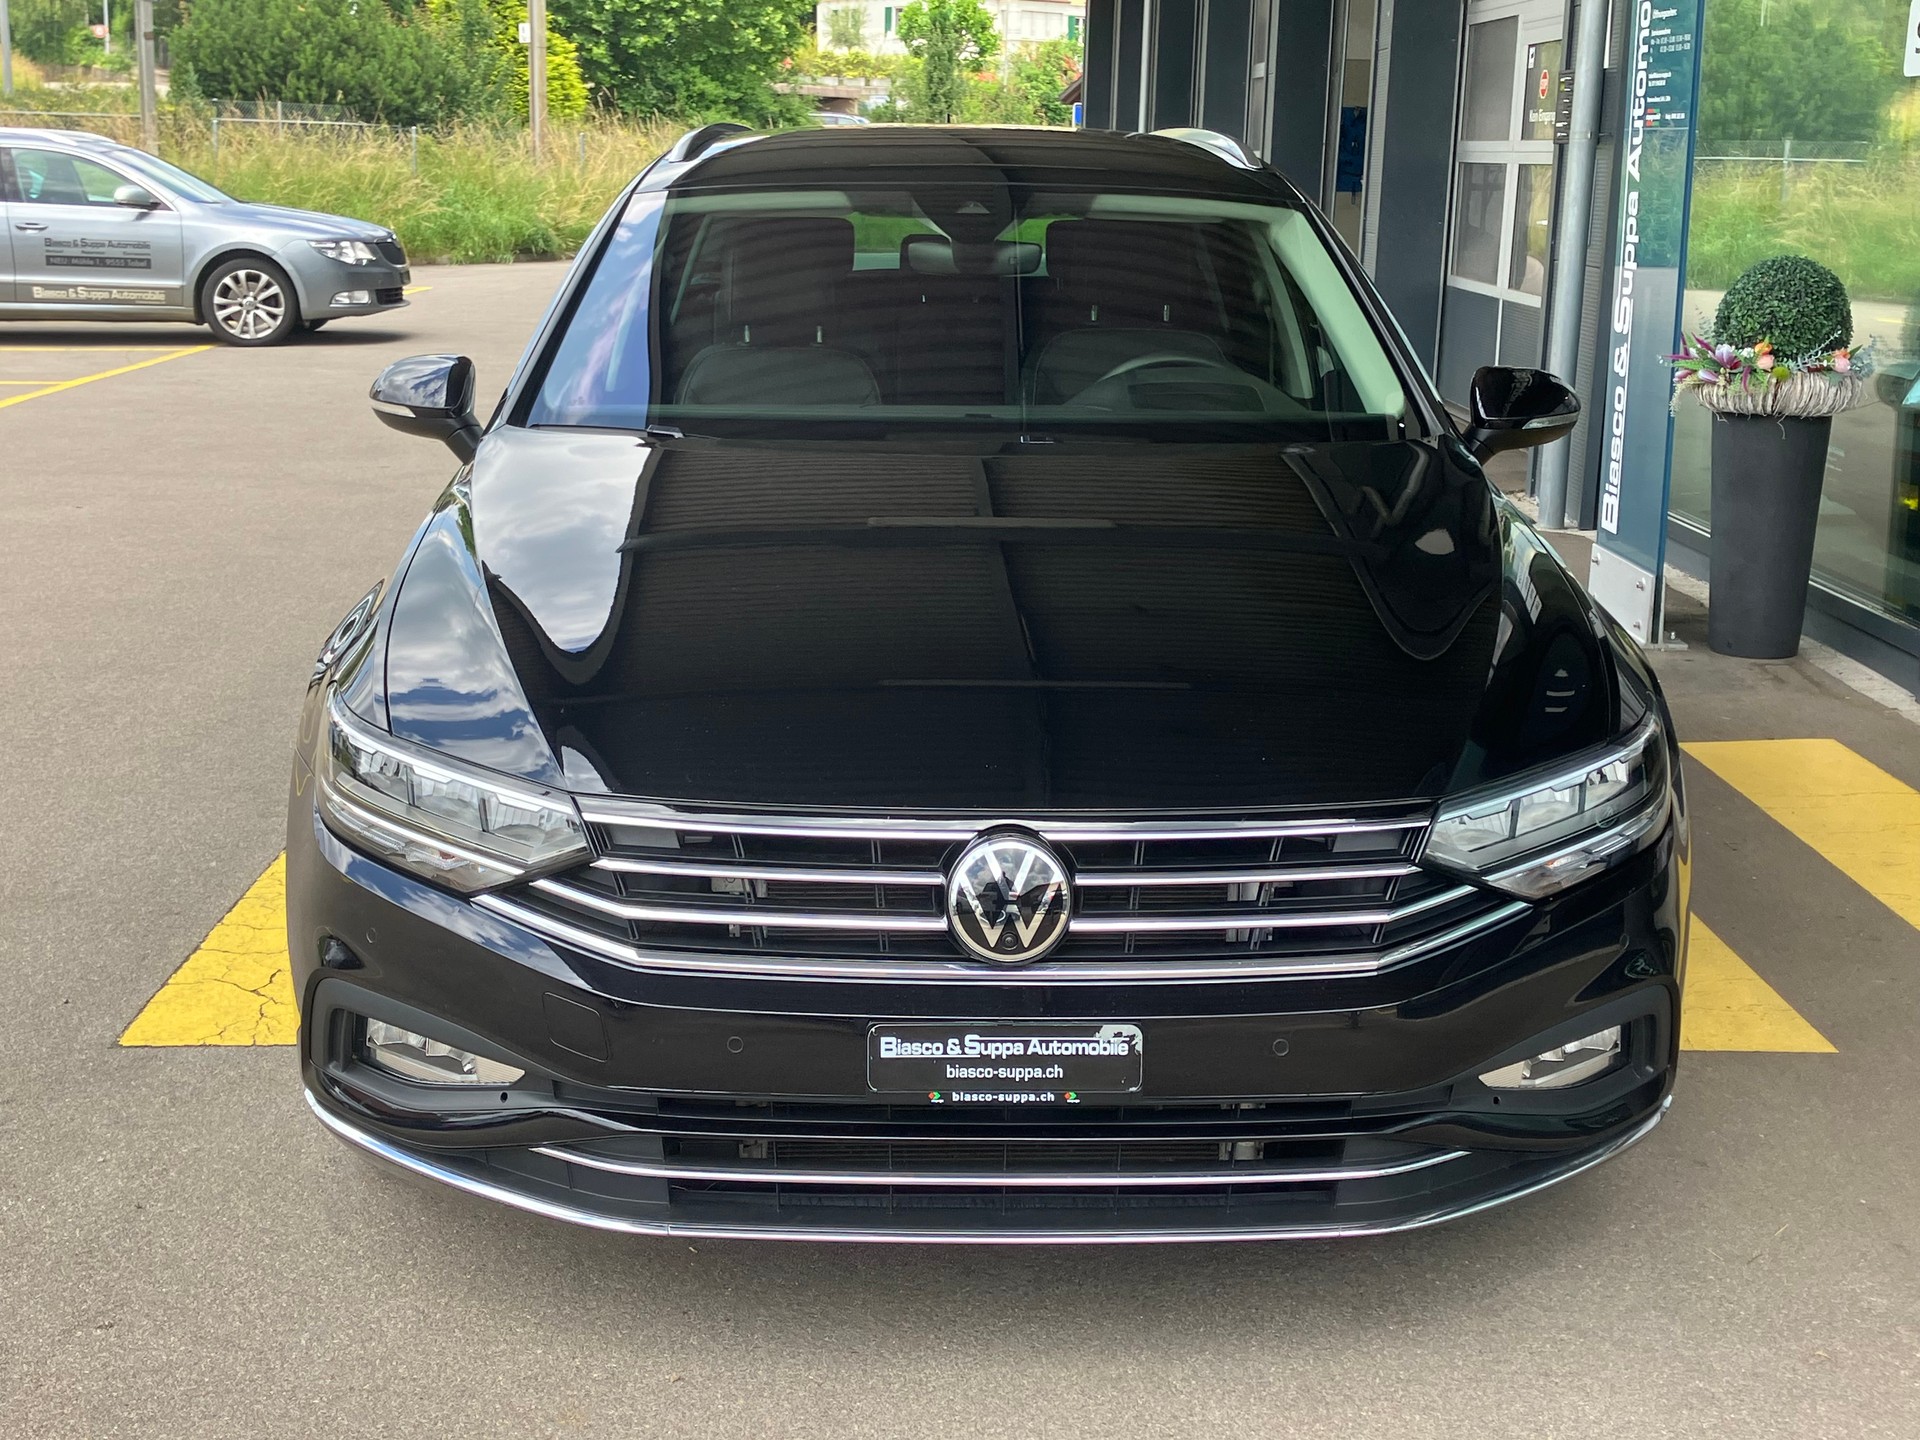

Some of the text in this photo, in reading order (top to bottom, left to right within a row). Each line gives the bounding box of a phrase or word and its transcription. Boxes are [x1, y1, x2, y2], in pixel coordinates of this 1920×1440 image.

[107, 240, 151, 250] Automobile
[1601, 0, 1652, 535] Biasco & Suppa Automo
[111, 289, 166, 301] Automobile
[880, 1034, 1130, 1059] Biasco & Suppa Automobile
[946, 1064, 1064, 1081] biasco-suppa.ch
